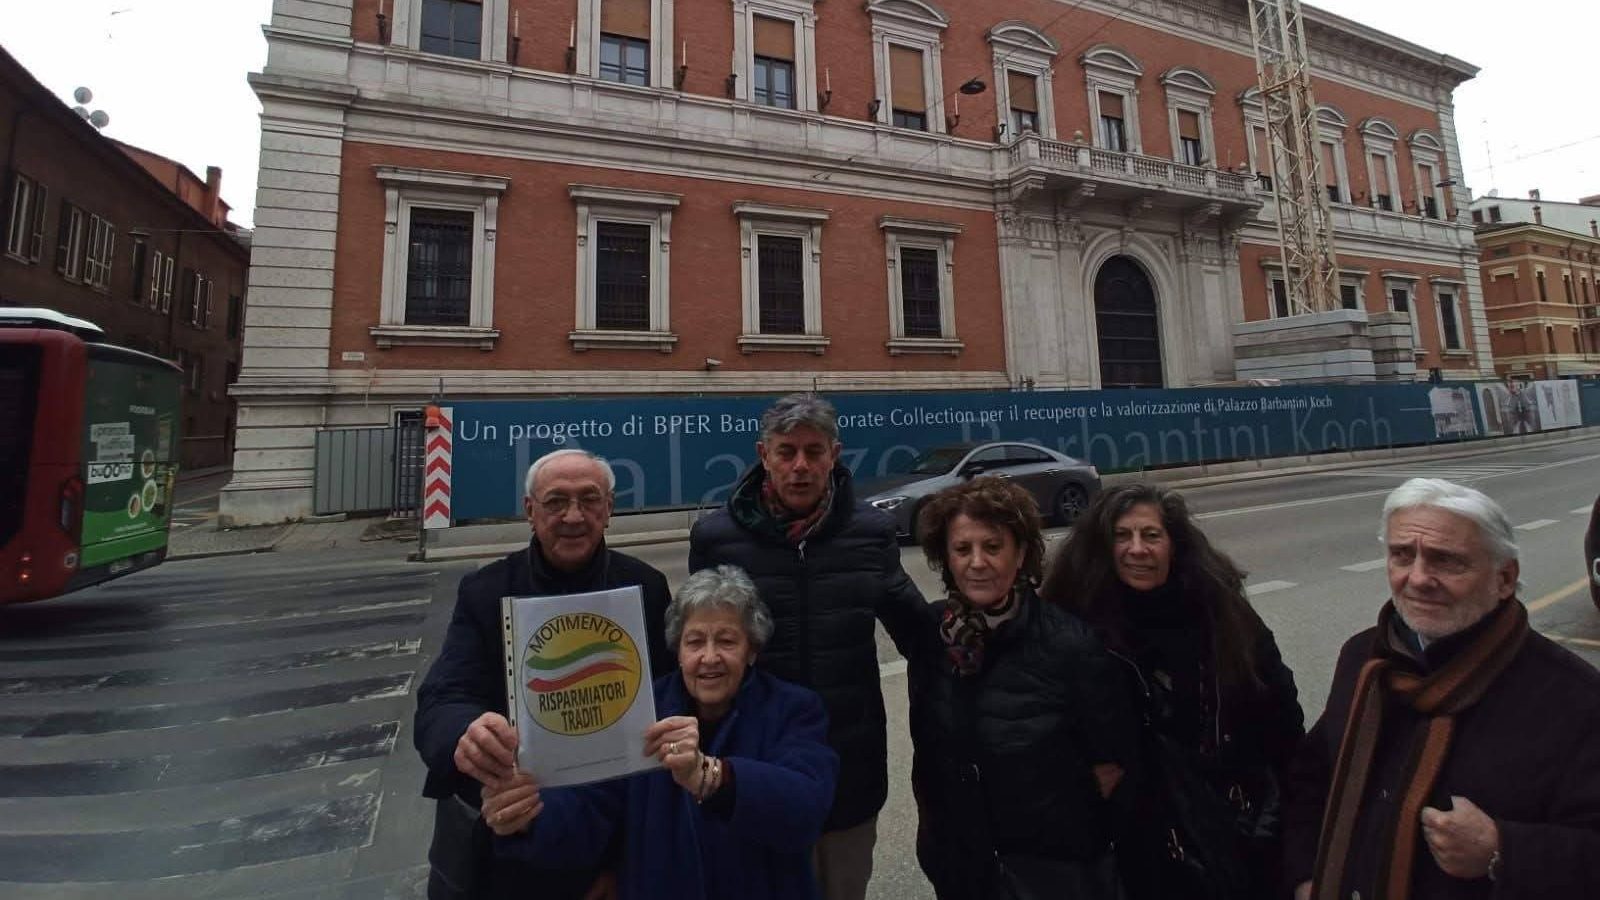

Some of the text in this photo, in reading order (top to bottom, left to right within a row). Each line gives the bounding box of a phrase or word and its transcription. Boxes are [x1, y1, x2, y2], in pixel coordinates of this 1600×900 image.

[459, 395, 1333, 446] Un progetto di BPER Ban orate Collection per il recupero e la valorizzazione di Palazzo Barbantini Koch
[1289, 396, 1394, 456] Koch
[529, 614, 624, 653] MOVIMENTO
[539, 680, 626, 713] RISPARMIATORI
[560, 707, 604, 732] TRADITI
